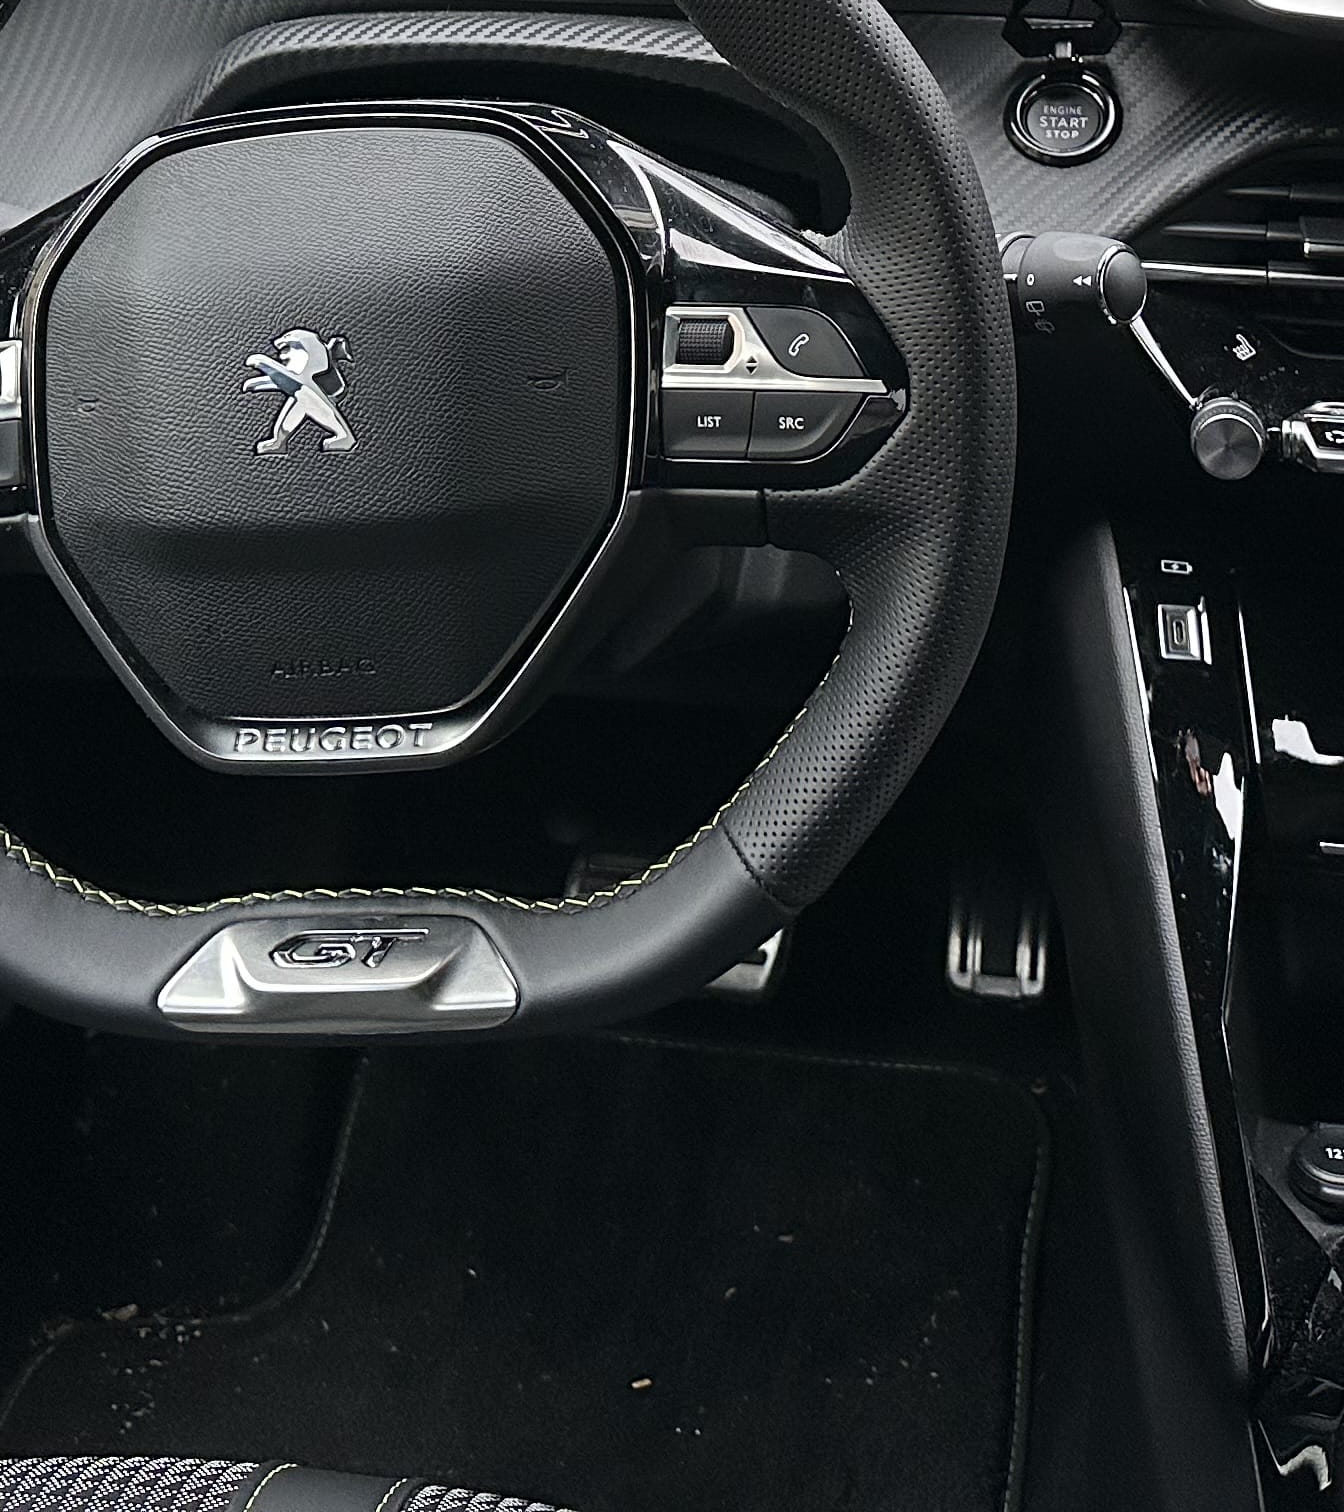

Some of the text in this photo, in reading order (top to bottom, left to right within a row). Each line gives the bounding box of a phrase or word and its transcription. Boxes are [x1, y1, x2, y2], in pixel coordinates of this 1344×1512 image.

[1043, 105, 1083, 116] ENGINE
[1039, 116, 1089, 128] START
[1045, 130, 1080, 140] STOP
[697, 416, 722, 428] LIST
[778, 417, 805, 430] SRC
[233, 722, 434, 753] PEUGEOT
[268, 928, 430, 969] GT
